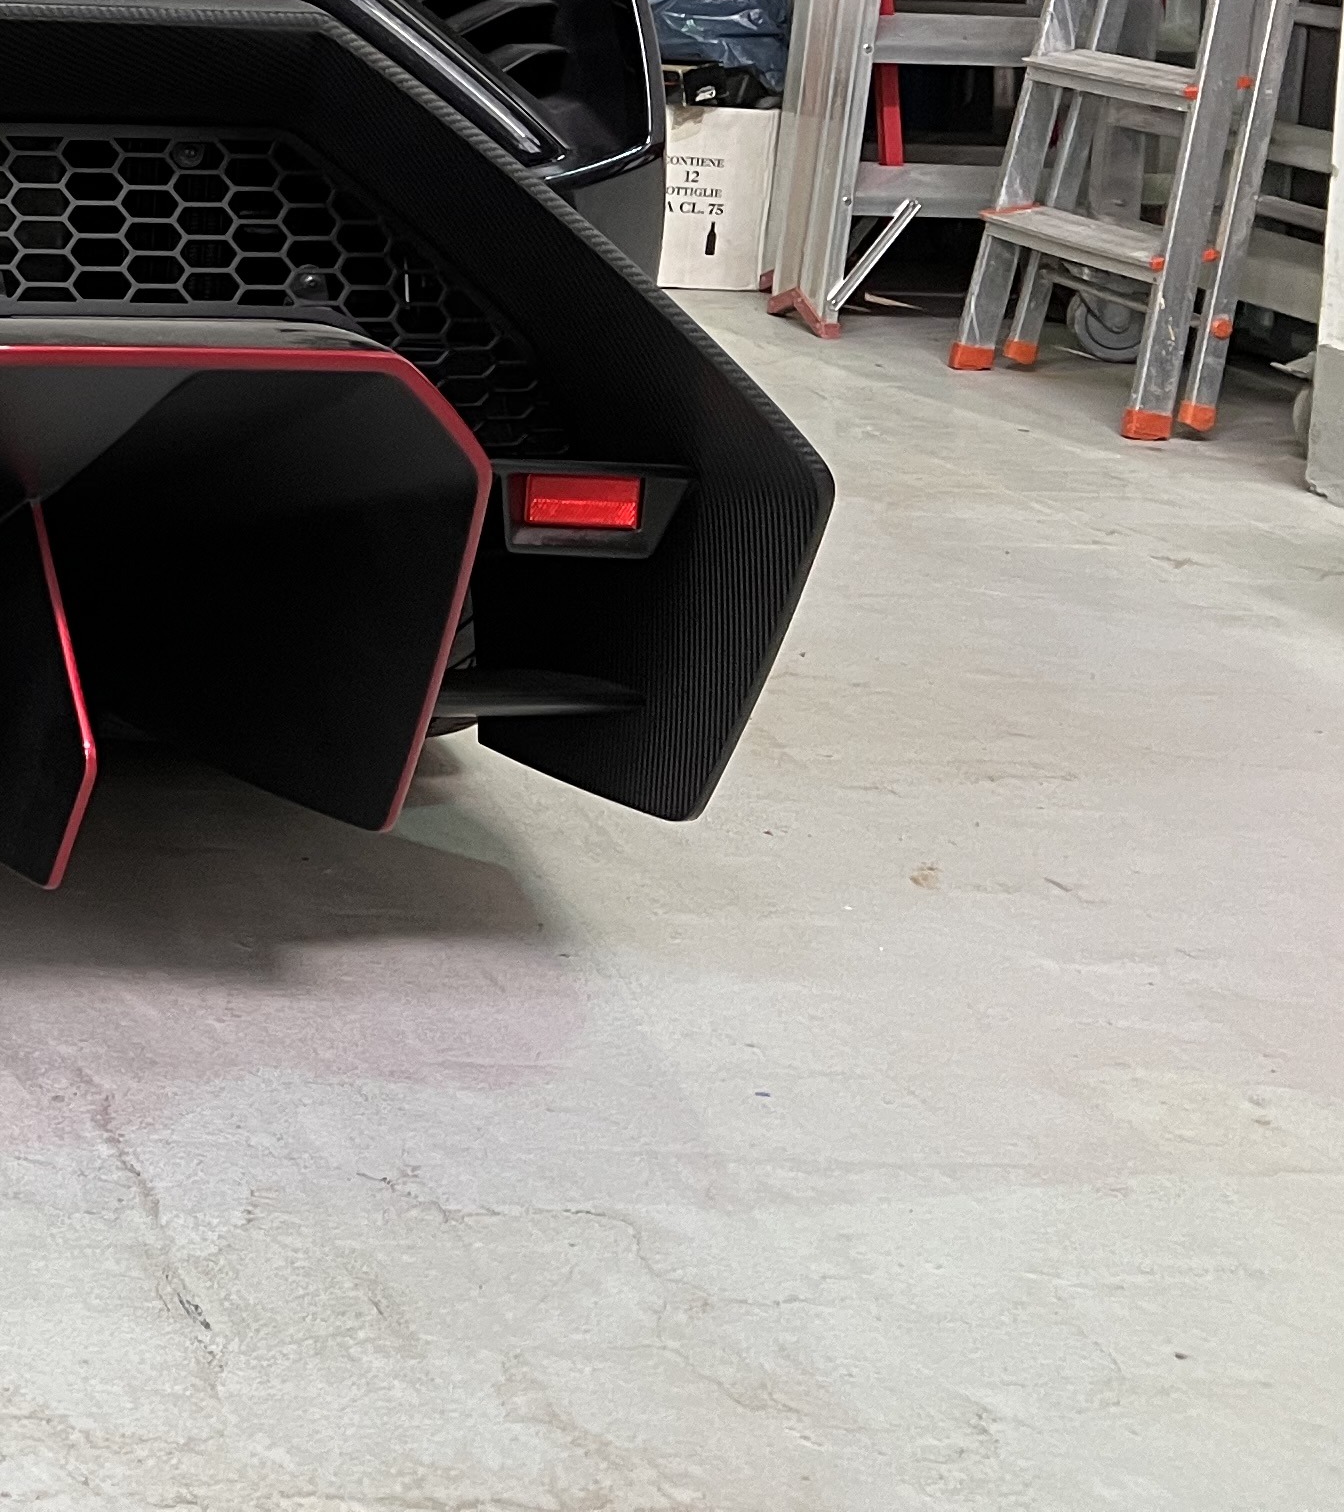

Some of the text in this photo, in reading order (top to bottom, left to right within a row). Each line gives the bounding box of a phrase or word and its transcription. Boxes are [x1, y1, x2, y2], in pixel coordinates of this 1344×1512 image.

[683, 170, 700, 183] 12
[666, 185, 723, 199] OTTIGLIE
[708, 202, 725, 216] 75
